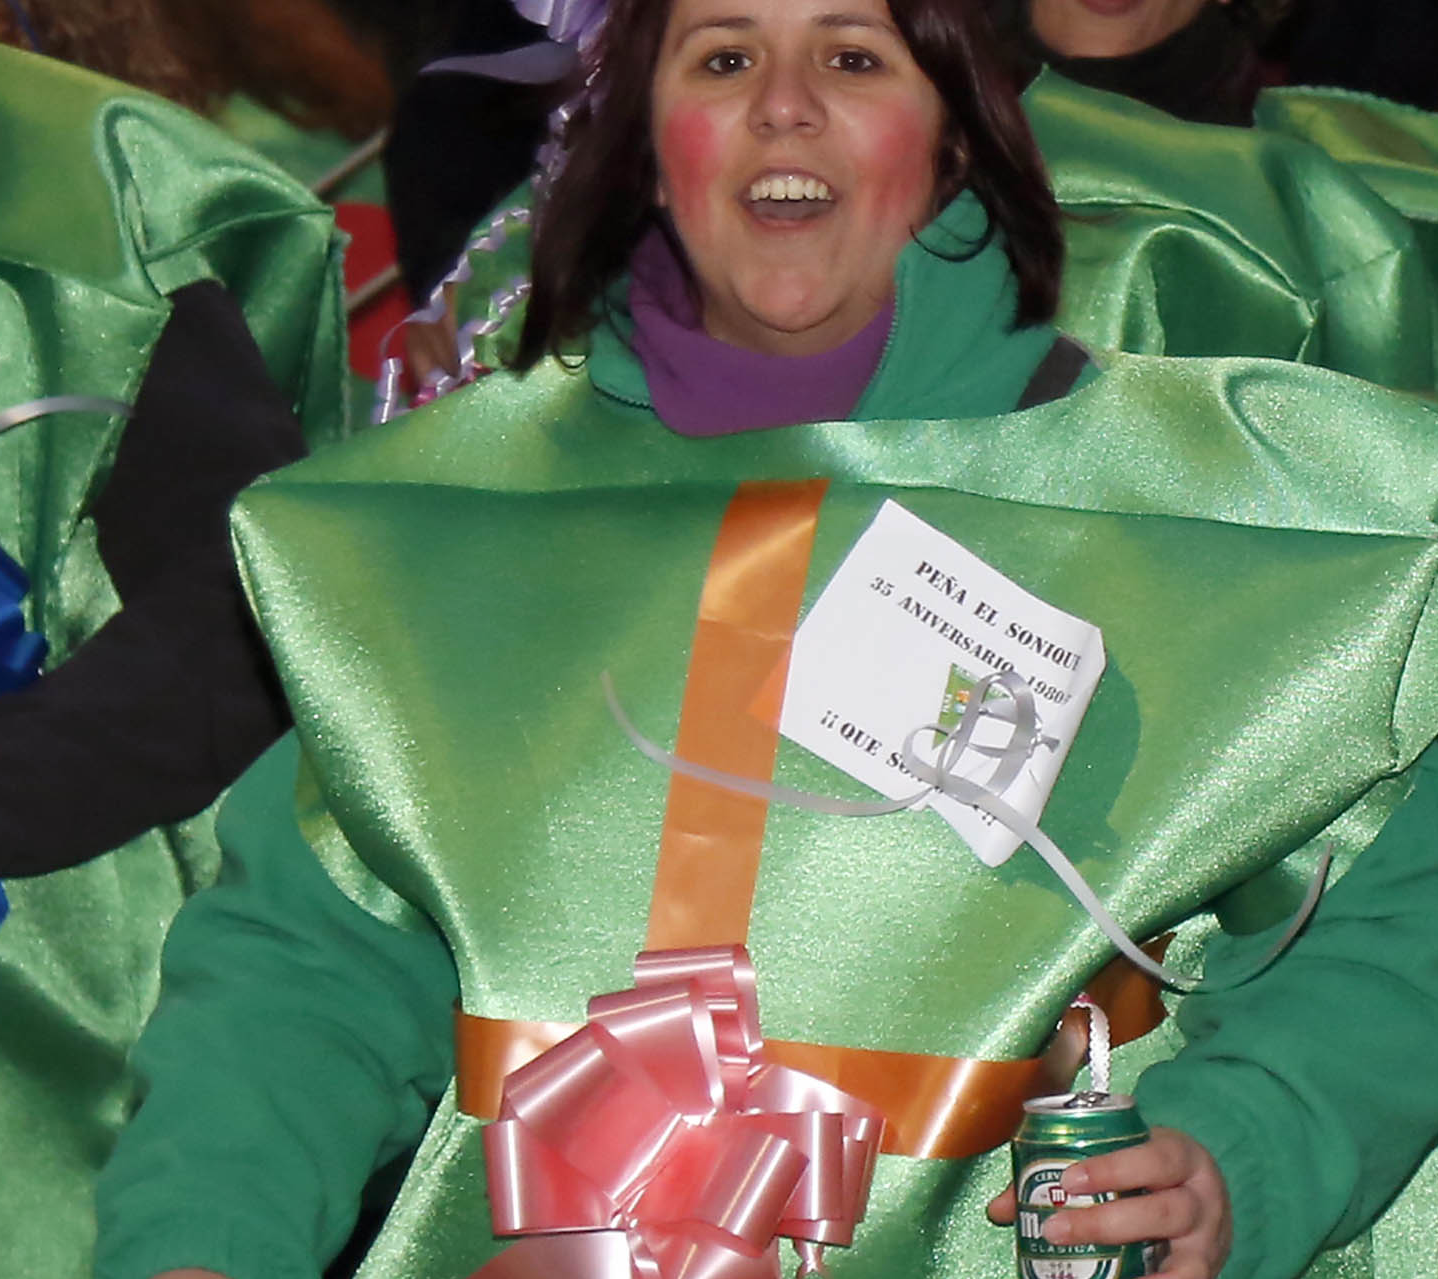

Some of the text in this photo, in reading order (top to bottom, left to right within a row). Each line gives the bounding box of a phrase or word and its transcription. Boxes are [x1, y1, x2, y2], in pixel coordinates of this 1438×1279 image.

[870, 576, 895, 597] 35
[898, 596, 1015, 673] ANIVERSARIO
[915, 561, 967, 605] PEÑA
[973, 601, 998, 627] EL
[1034, 1171, 1062, 1183] CERV
